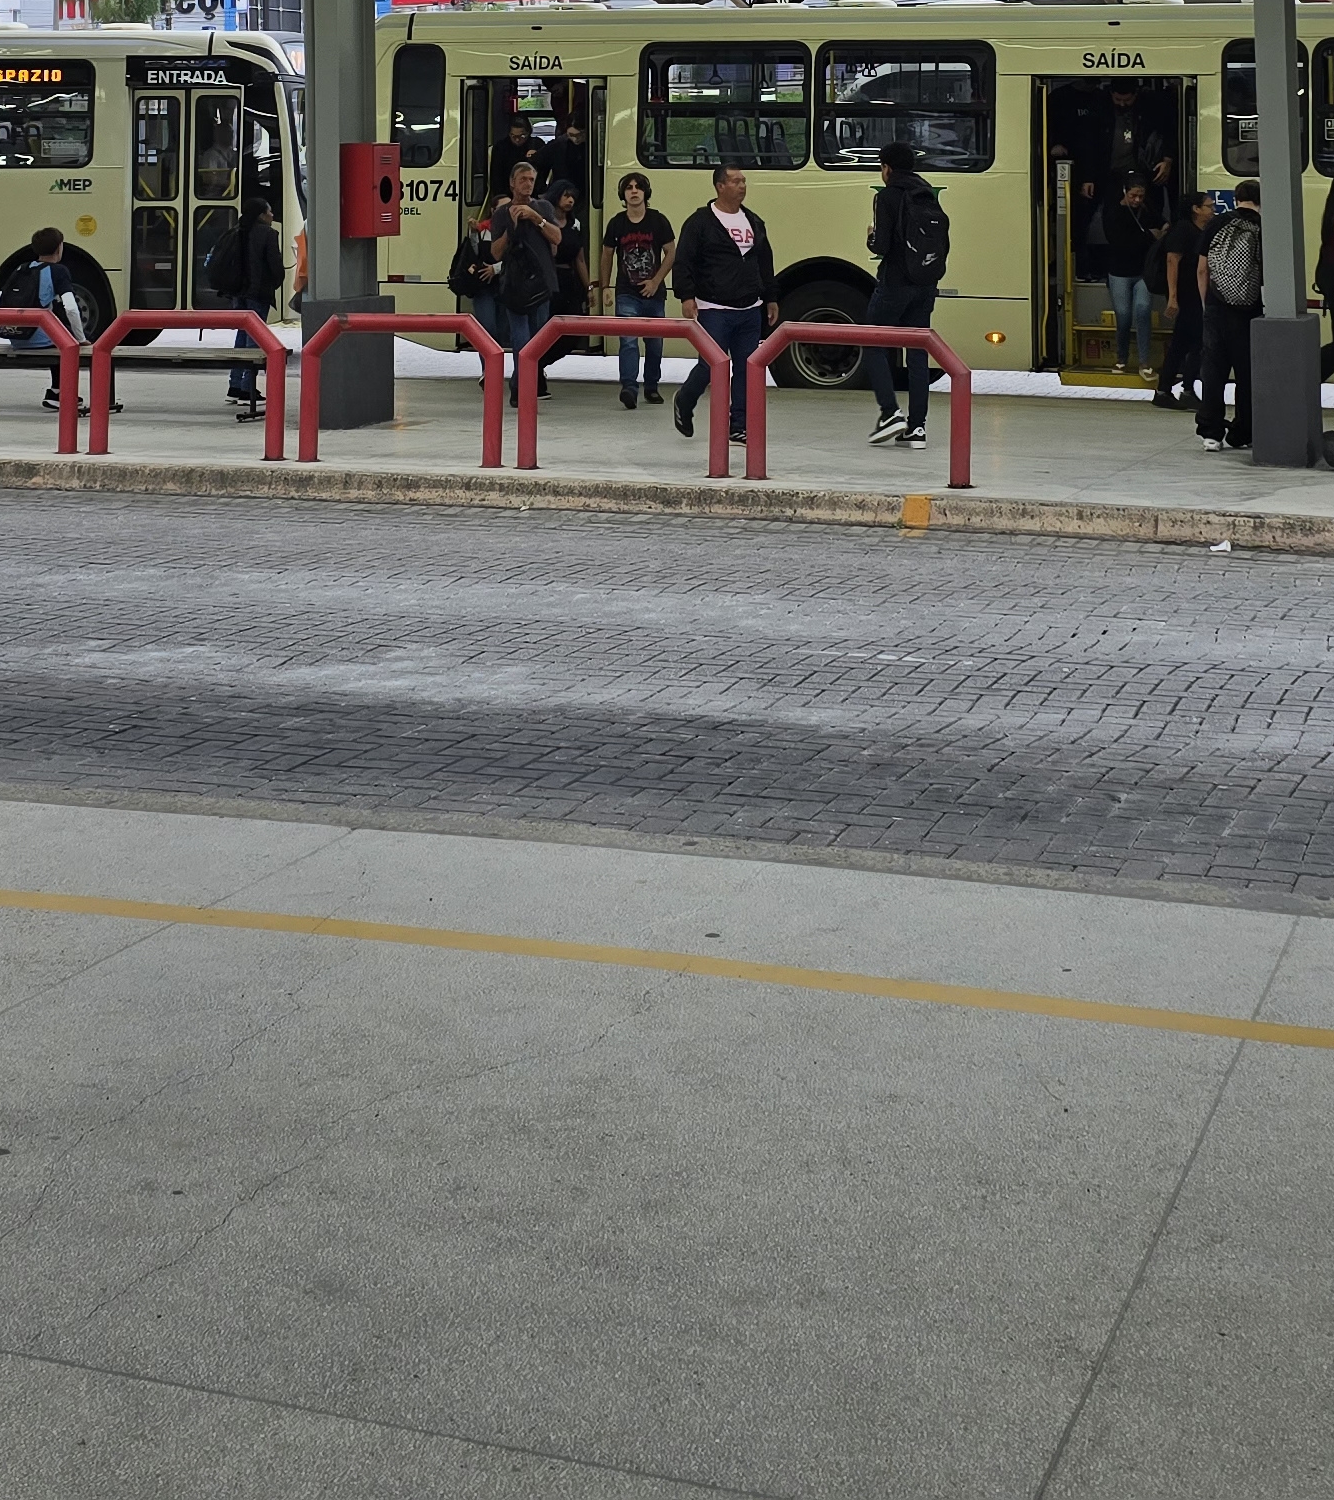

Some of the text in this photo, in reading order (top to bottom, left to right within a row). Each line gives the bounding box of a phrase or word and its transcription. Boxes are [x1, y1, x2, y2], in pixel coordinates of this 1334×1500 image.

[509, 50, 563, 71] SAÍDA
[1082, 48, 1146, 69] SAÍDA
[147, 70, 227, 84] ENTRADA
[48, 178, 93, 192] AMEP
[726, 227, 755, 244] SA
